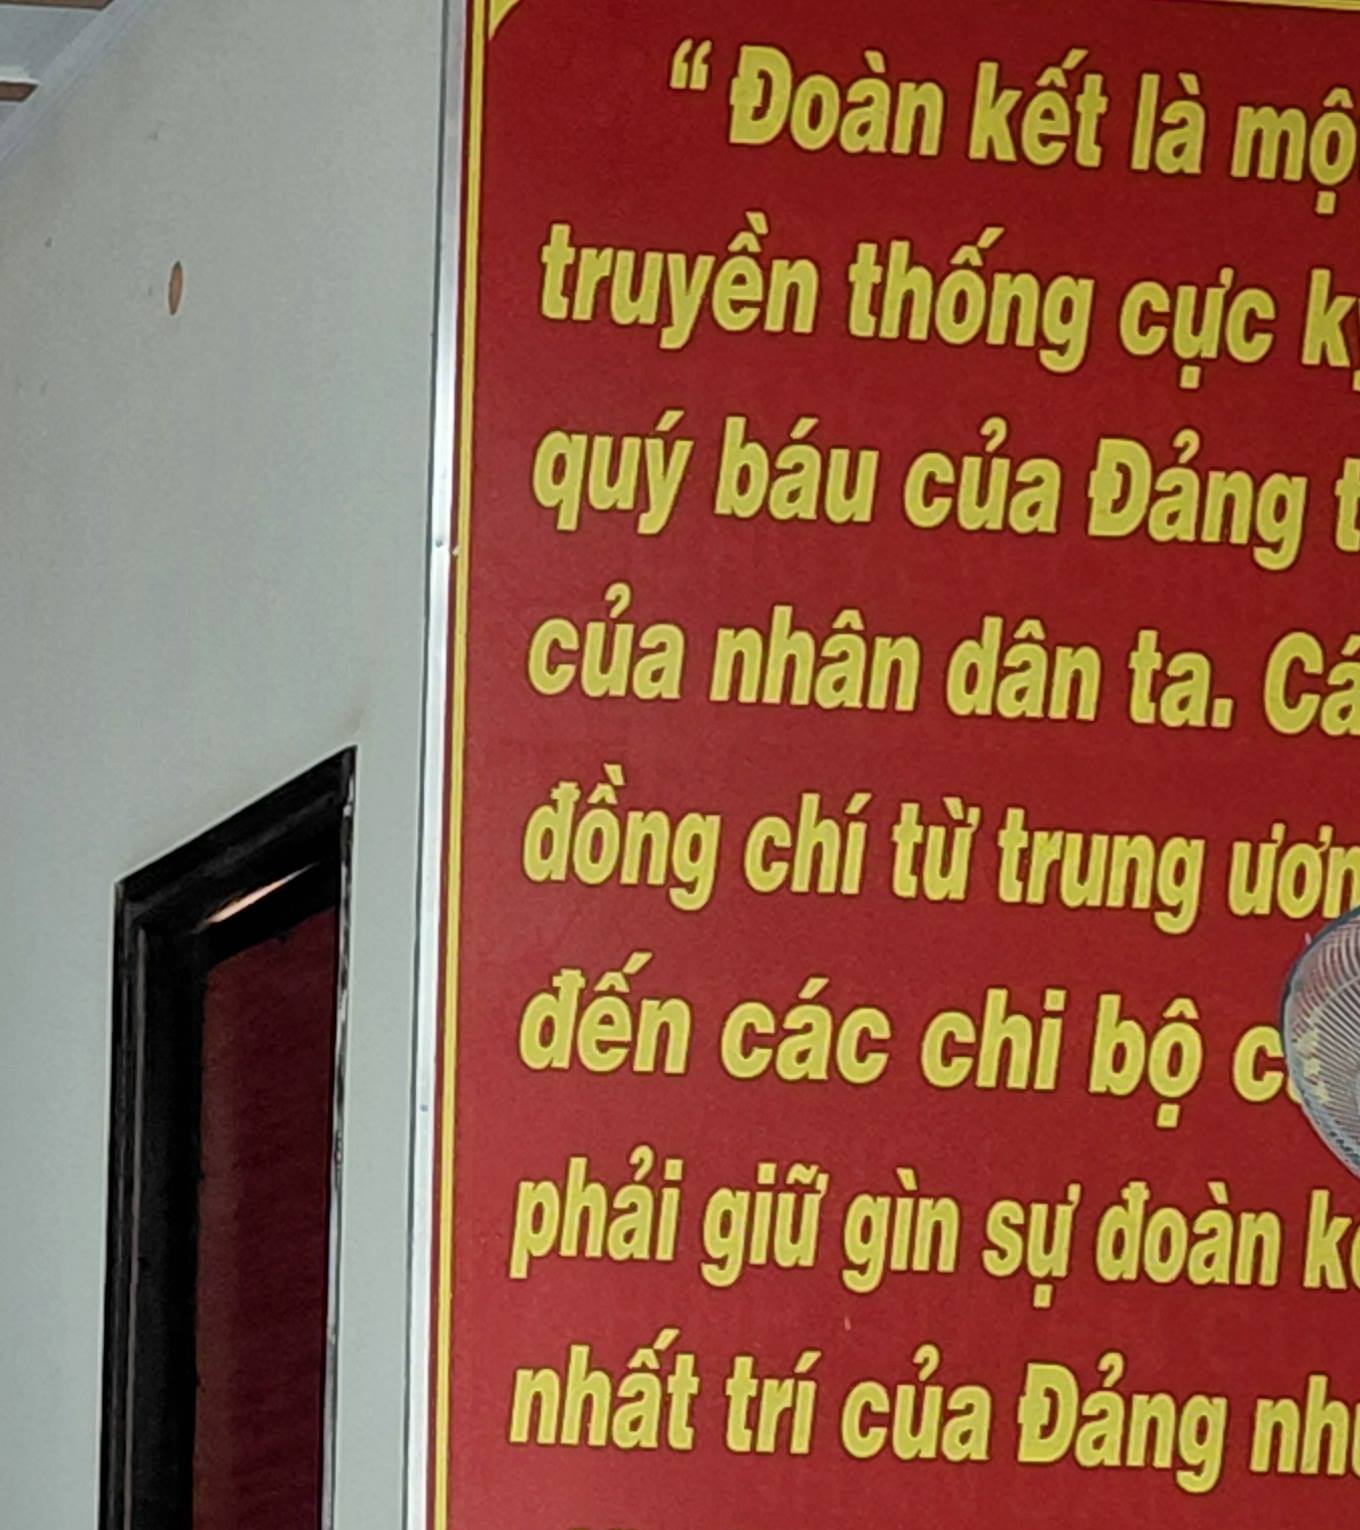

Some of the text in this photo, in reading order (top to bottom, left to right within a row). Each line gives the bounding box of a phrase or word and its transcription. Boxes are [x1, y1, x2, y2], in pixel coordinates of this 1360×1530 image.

[967, 47, 1109, 169] kết
[1130, 72, 1207, 175] là
[539, 210, 1360, 393] truyền thống cực k
[531, 408, 696, 536] quý
[713, 414, 881, 525] báu
[902, 415, 1062, 535] của
[1086, 427, 1309, 572] Đảng
[526, 581, 686, 701] của
[708, 603, 922, 713] nhân
[945, 614, 1102, 722] dân
[1127, 628, 1235, 729] ta.
[521, 762, 723, 912] đồng
[742, 791, 872, 896] chí
[890, 795, 982, 902] từ
[996, 806, 1207, 936] trung
[517, 950, 693, 1075] đến
[719, 976, 893, 1085] các
[919, 987, 1068, 1091] chi
[1087, 992, 1204, 1129] bộ
[508, 1143, 685, 1281] phải
[699, 1161, 831, 1289] giữ
[840, 1166, 961, 1295] gìn
[980, 1182, 1082, 1309] sự
[1094, 1179, 1282, 1288] đoàn
[507, 1326, 1360, 1495] nhất trí của Đảng nh
